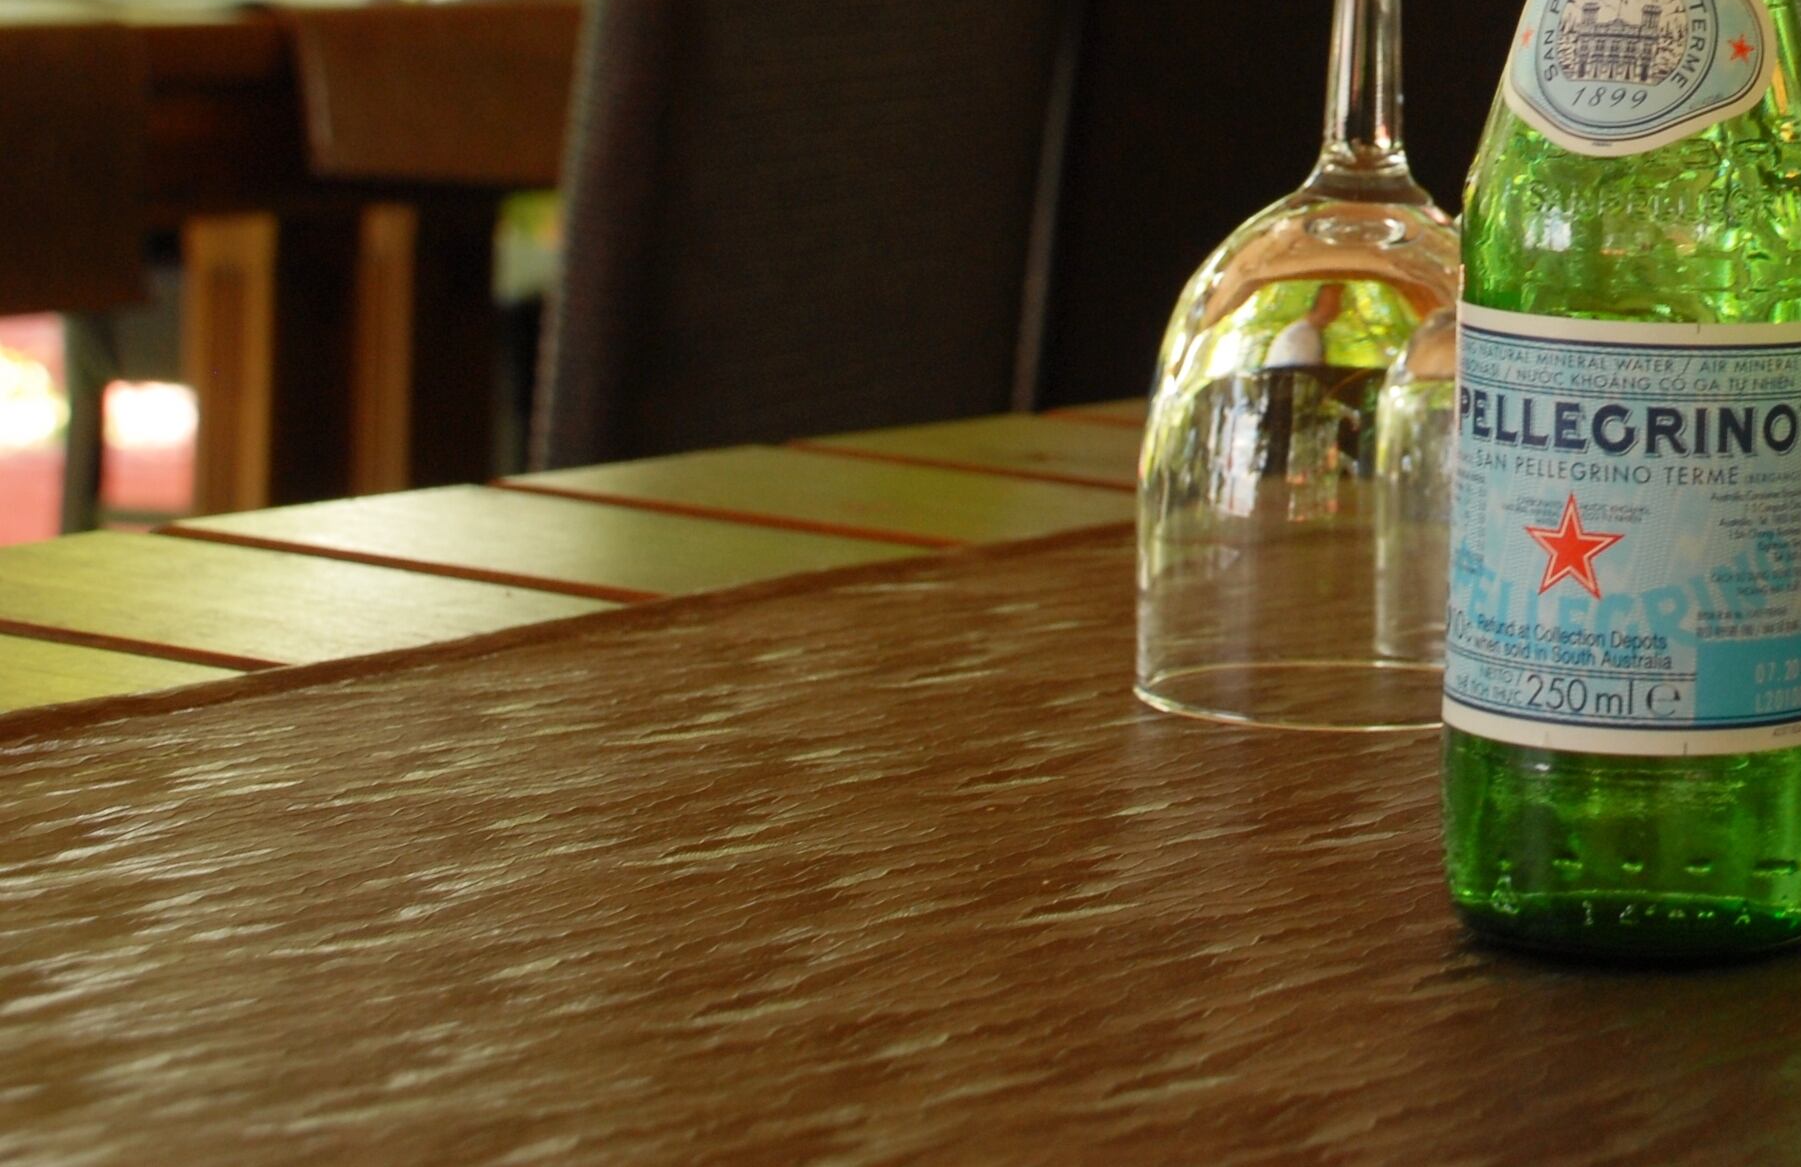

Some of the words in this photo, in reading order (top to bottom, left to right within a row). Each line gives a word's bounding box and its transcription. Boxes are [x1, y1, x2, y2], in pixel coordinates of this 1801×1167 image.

[1543, 29, 1558, 82] SAN
[1671, 0, 1707, 90] TERME
[1571, 86, 1649, 109] 1899
[1537, 353, 1607, 371] MINERAL
[1615, 357, 1674, 373] WATER
[1699, 358, 1727, 373] AIR
[1734, 357, 1800, 373] MINERAL
[1694, 378, 1720, 392] GA
[1475, 449, 1507, 471] SAN
[1515, 456, 1651, 484] PELLEGRINO
[1664, 466, 1740, 486] TERME
[1535, 623, 1605, 647] Collection
[1610, 631, 1668, 653] Depots
[1503, 641, 1531, 660] sold
[1534, 644, 1548, 660] in
[1552, 646, 1597, 667] South
[1601, 650, 1673, 670] Australia
[1527, 674, 1588, 712] 250
[1595, 681, 1633, 715] ml
